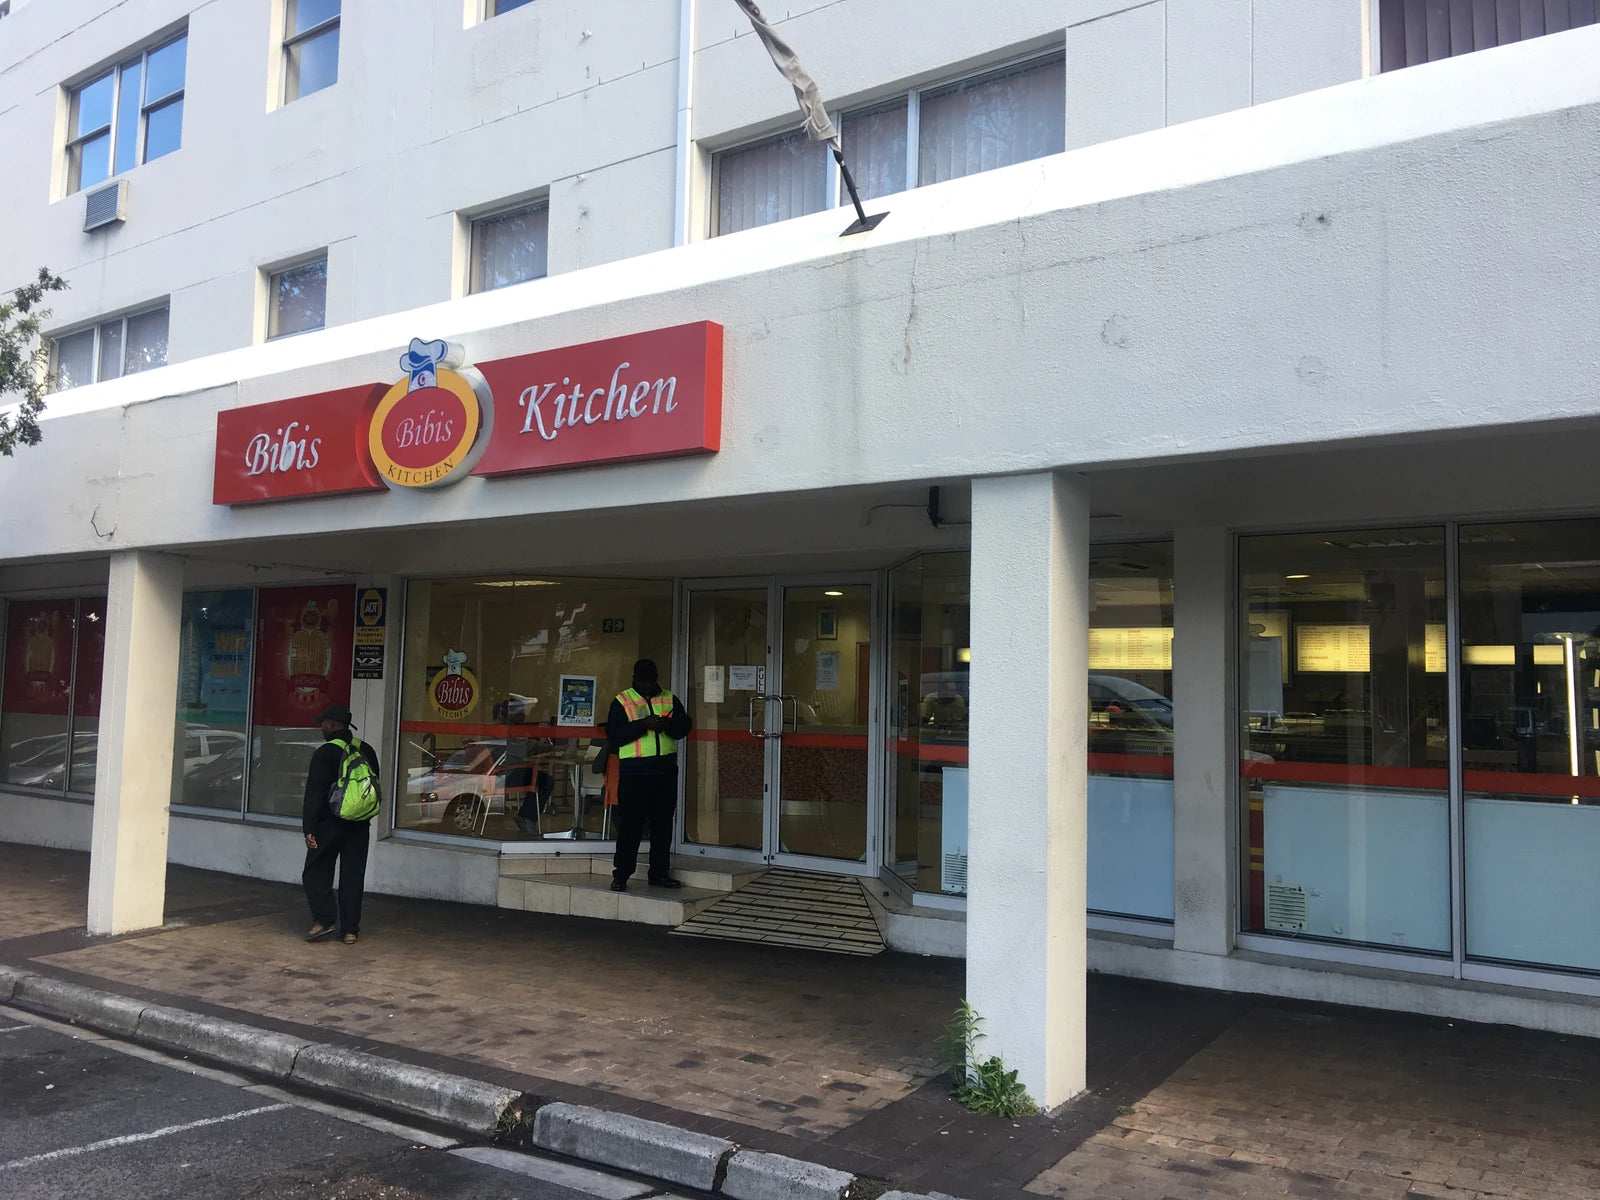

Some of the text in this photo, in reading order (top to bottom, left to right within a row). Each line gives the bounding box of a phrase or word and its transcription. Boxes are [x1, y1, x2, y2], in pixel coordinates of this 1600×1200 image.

[519, 362, 678, 440] Kitchen
[395, 409, 454, 450] Bibis
[246, 421, 322, 476] Bibis
[387, 456, 455, 486] KITCHEN
[364, 601, 379, 613] ADT
[438, 676, 470, 705] Bibis
[437, 706, 469, 719] KITCHEN
